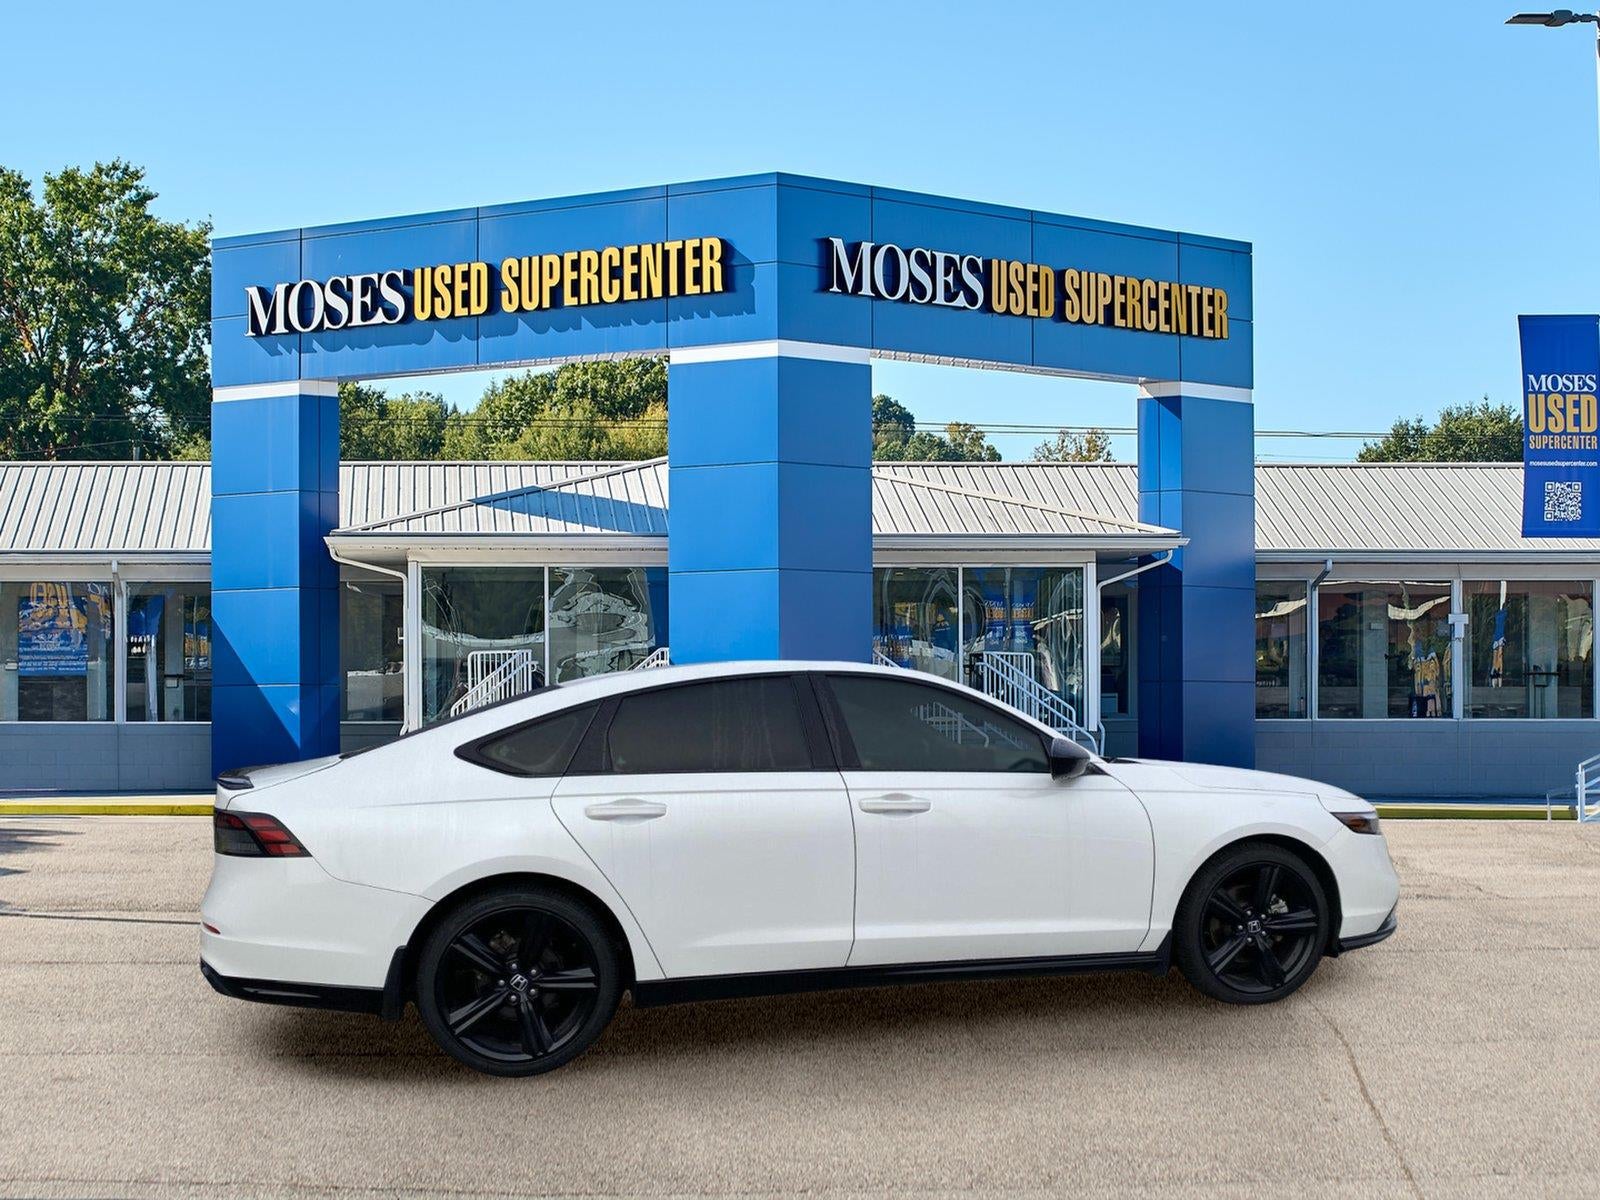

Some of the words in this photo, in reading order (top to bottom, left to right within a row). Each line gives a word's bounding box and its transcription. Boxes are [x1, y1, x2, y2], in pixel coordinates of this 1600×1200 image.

[244, 270, 407, 336] MOSES
[413, 261, 489, 321] USED
[501, 237, 724, 313] SUPERCENTER
[828, 237, 984, 310] MOSES
[991, 259, 1055, 318] USED
[1065, 268, 1229, 338] SUPERCENTER
[1527, 374, 1597, 392] MOSES
[1528, 394, 1598, 433] USED
[1529, 435, 1598, 450] SUPERCENTER
